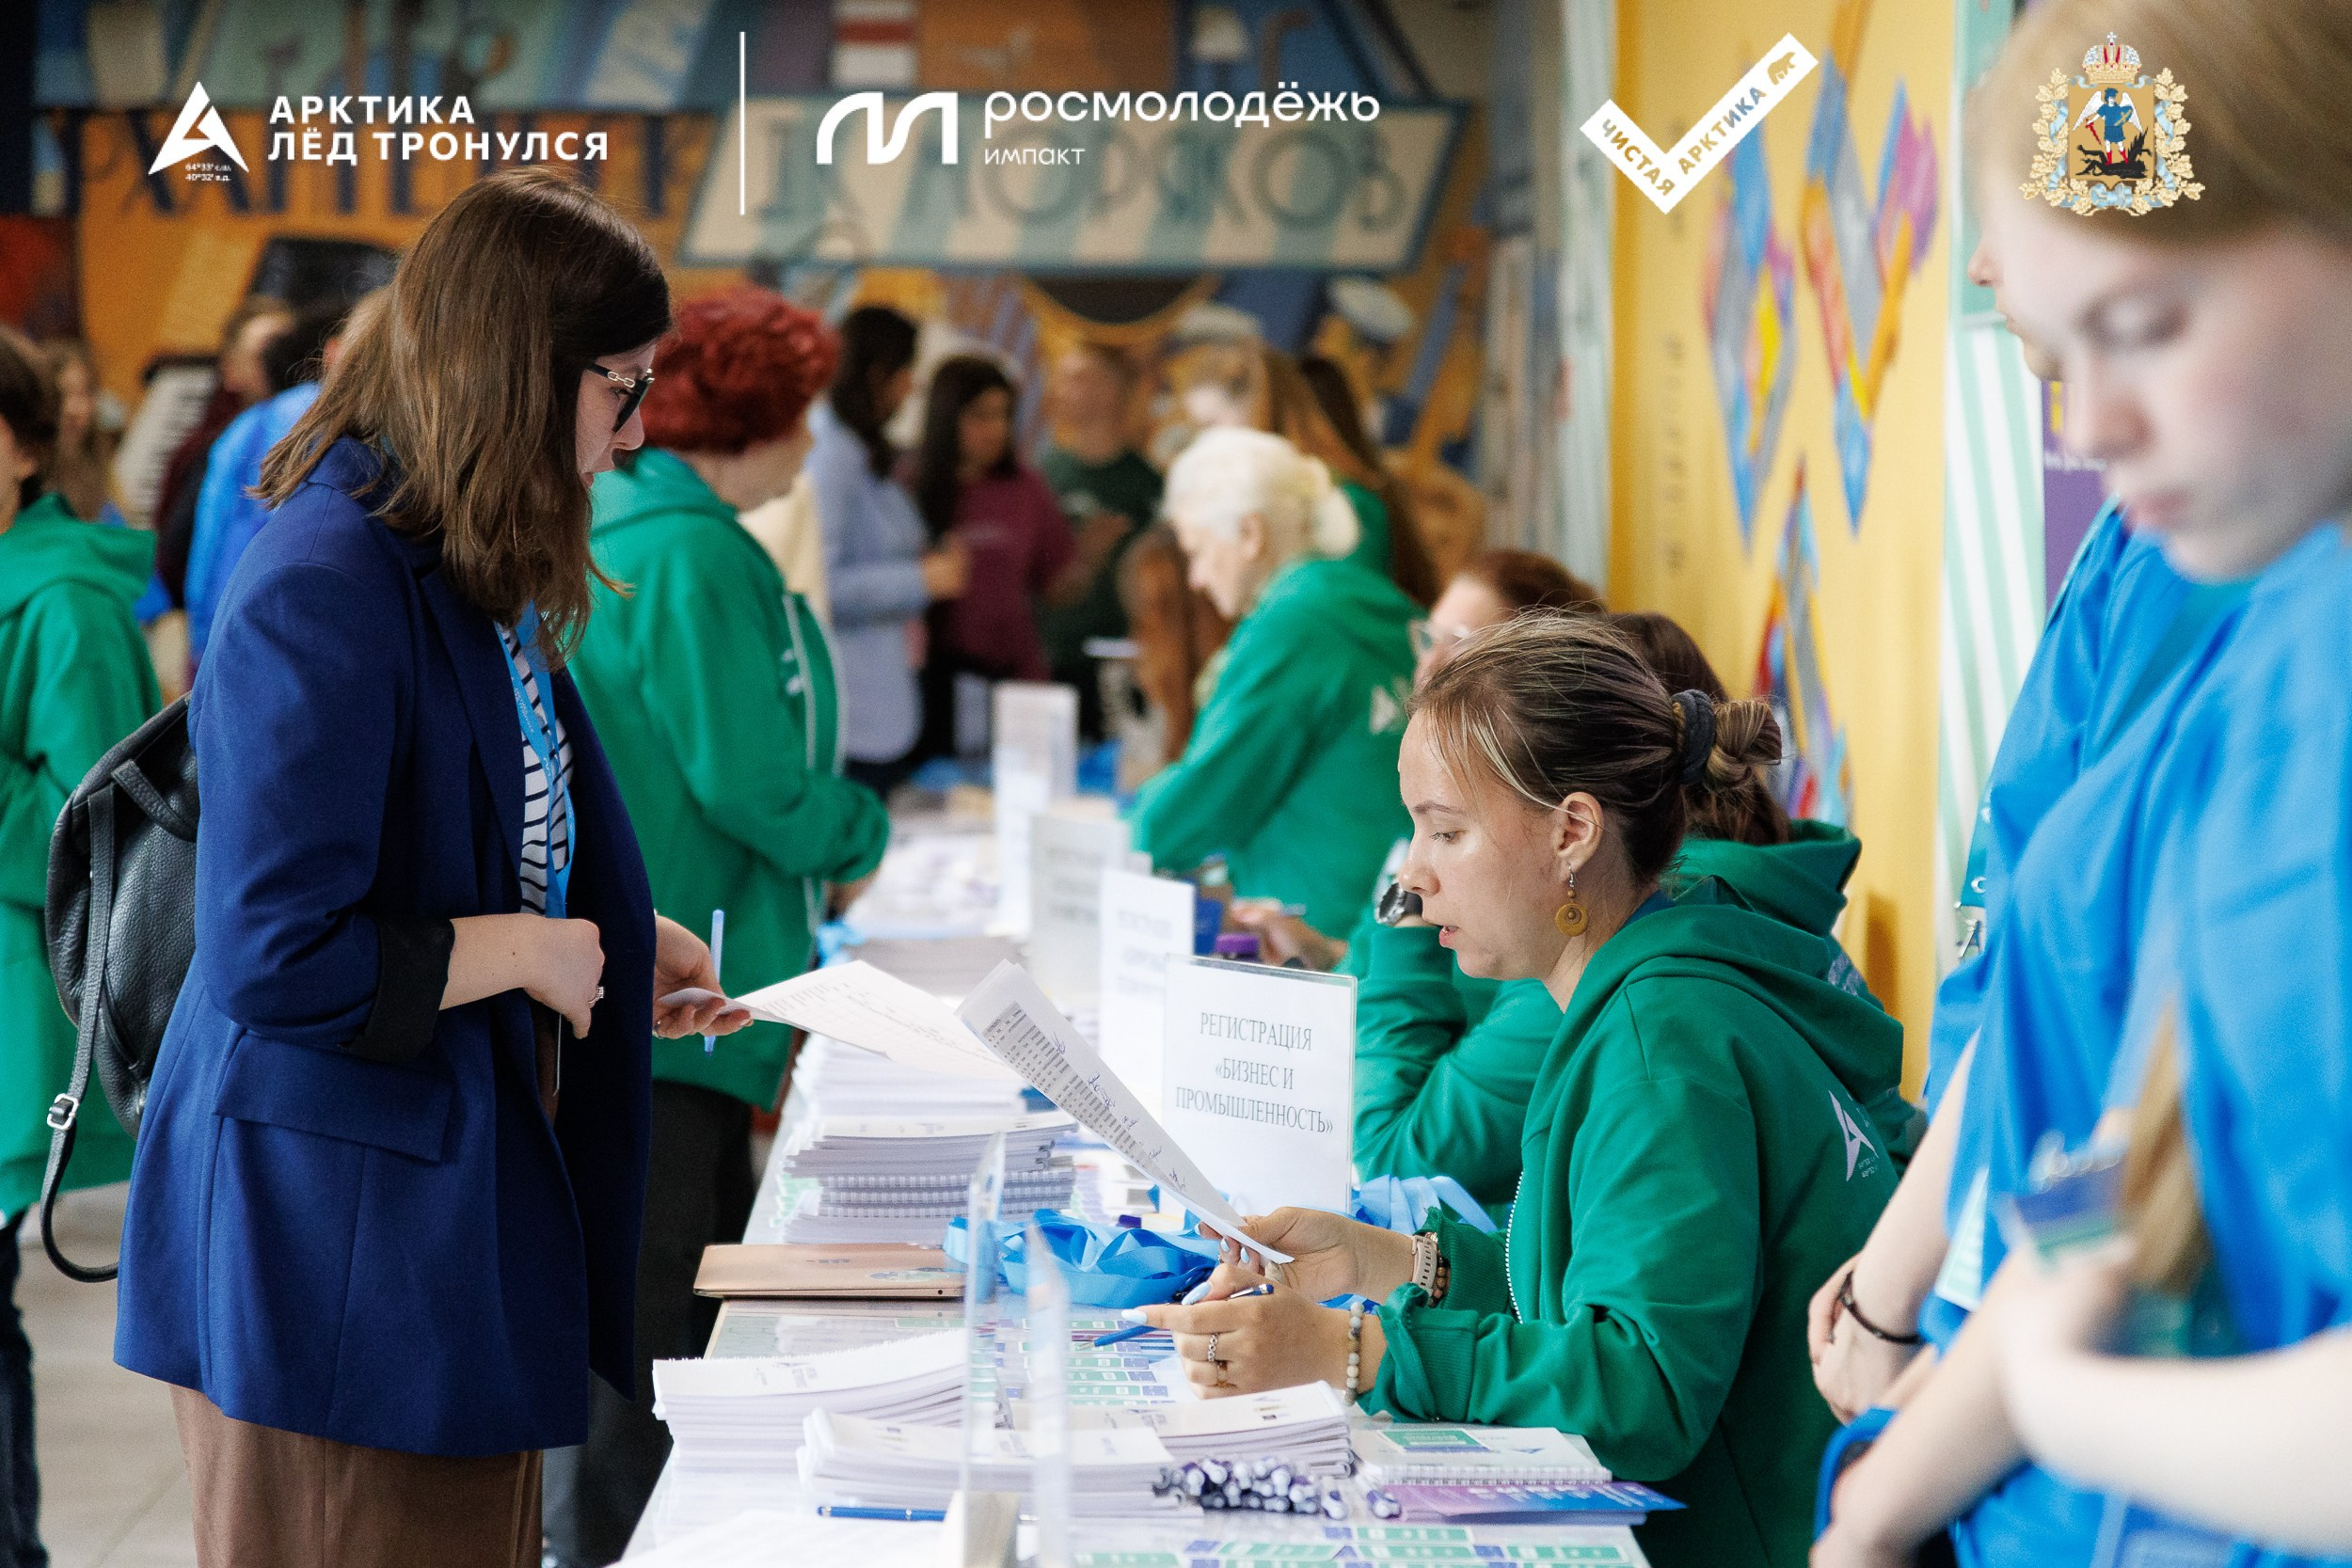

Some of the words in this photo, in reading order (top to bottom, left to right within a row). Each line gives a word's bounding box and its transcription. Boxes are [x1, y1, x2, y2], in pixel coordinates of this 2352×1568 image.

[1200, 1011, 1312, 1053] РЕГИСТРАЦИЯ
[1215, 1057, 1279, 1088] «БИЗНЕС
[1282, 1067, 1294, 1090] И
[1176, 1085, 1334, 1133] ПРОМЫШЛЕННОСТЬ»
